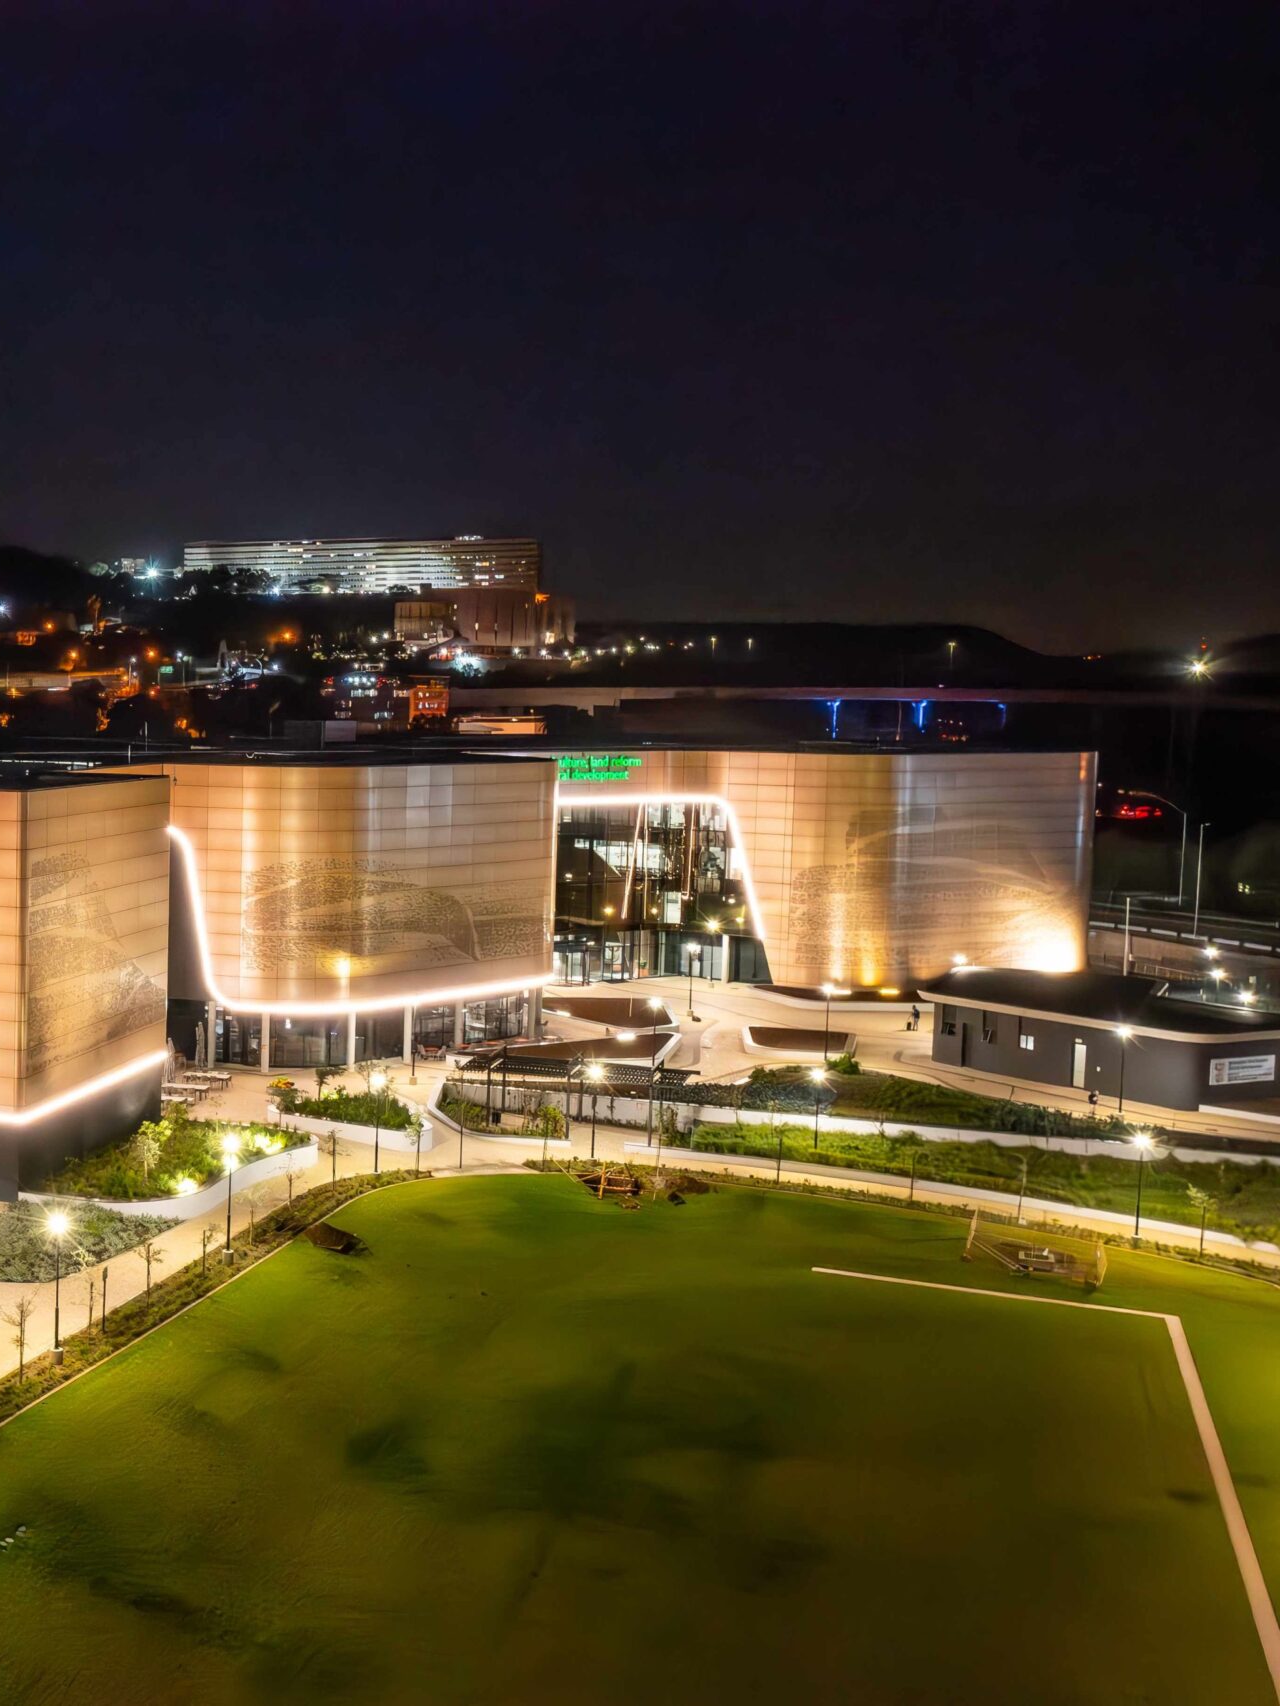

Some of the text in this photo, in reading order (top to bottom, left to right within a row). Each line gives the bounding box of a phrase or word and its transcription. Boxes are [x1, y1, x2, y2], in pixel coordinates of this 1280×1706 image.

[590, 755, 609, 767] land
[611, 755, 642, 767] reform
[572, 769, 629, 782] development
